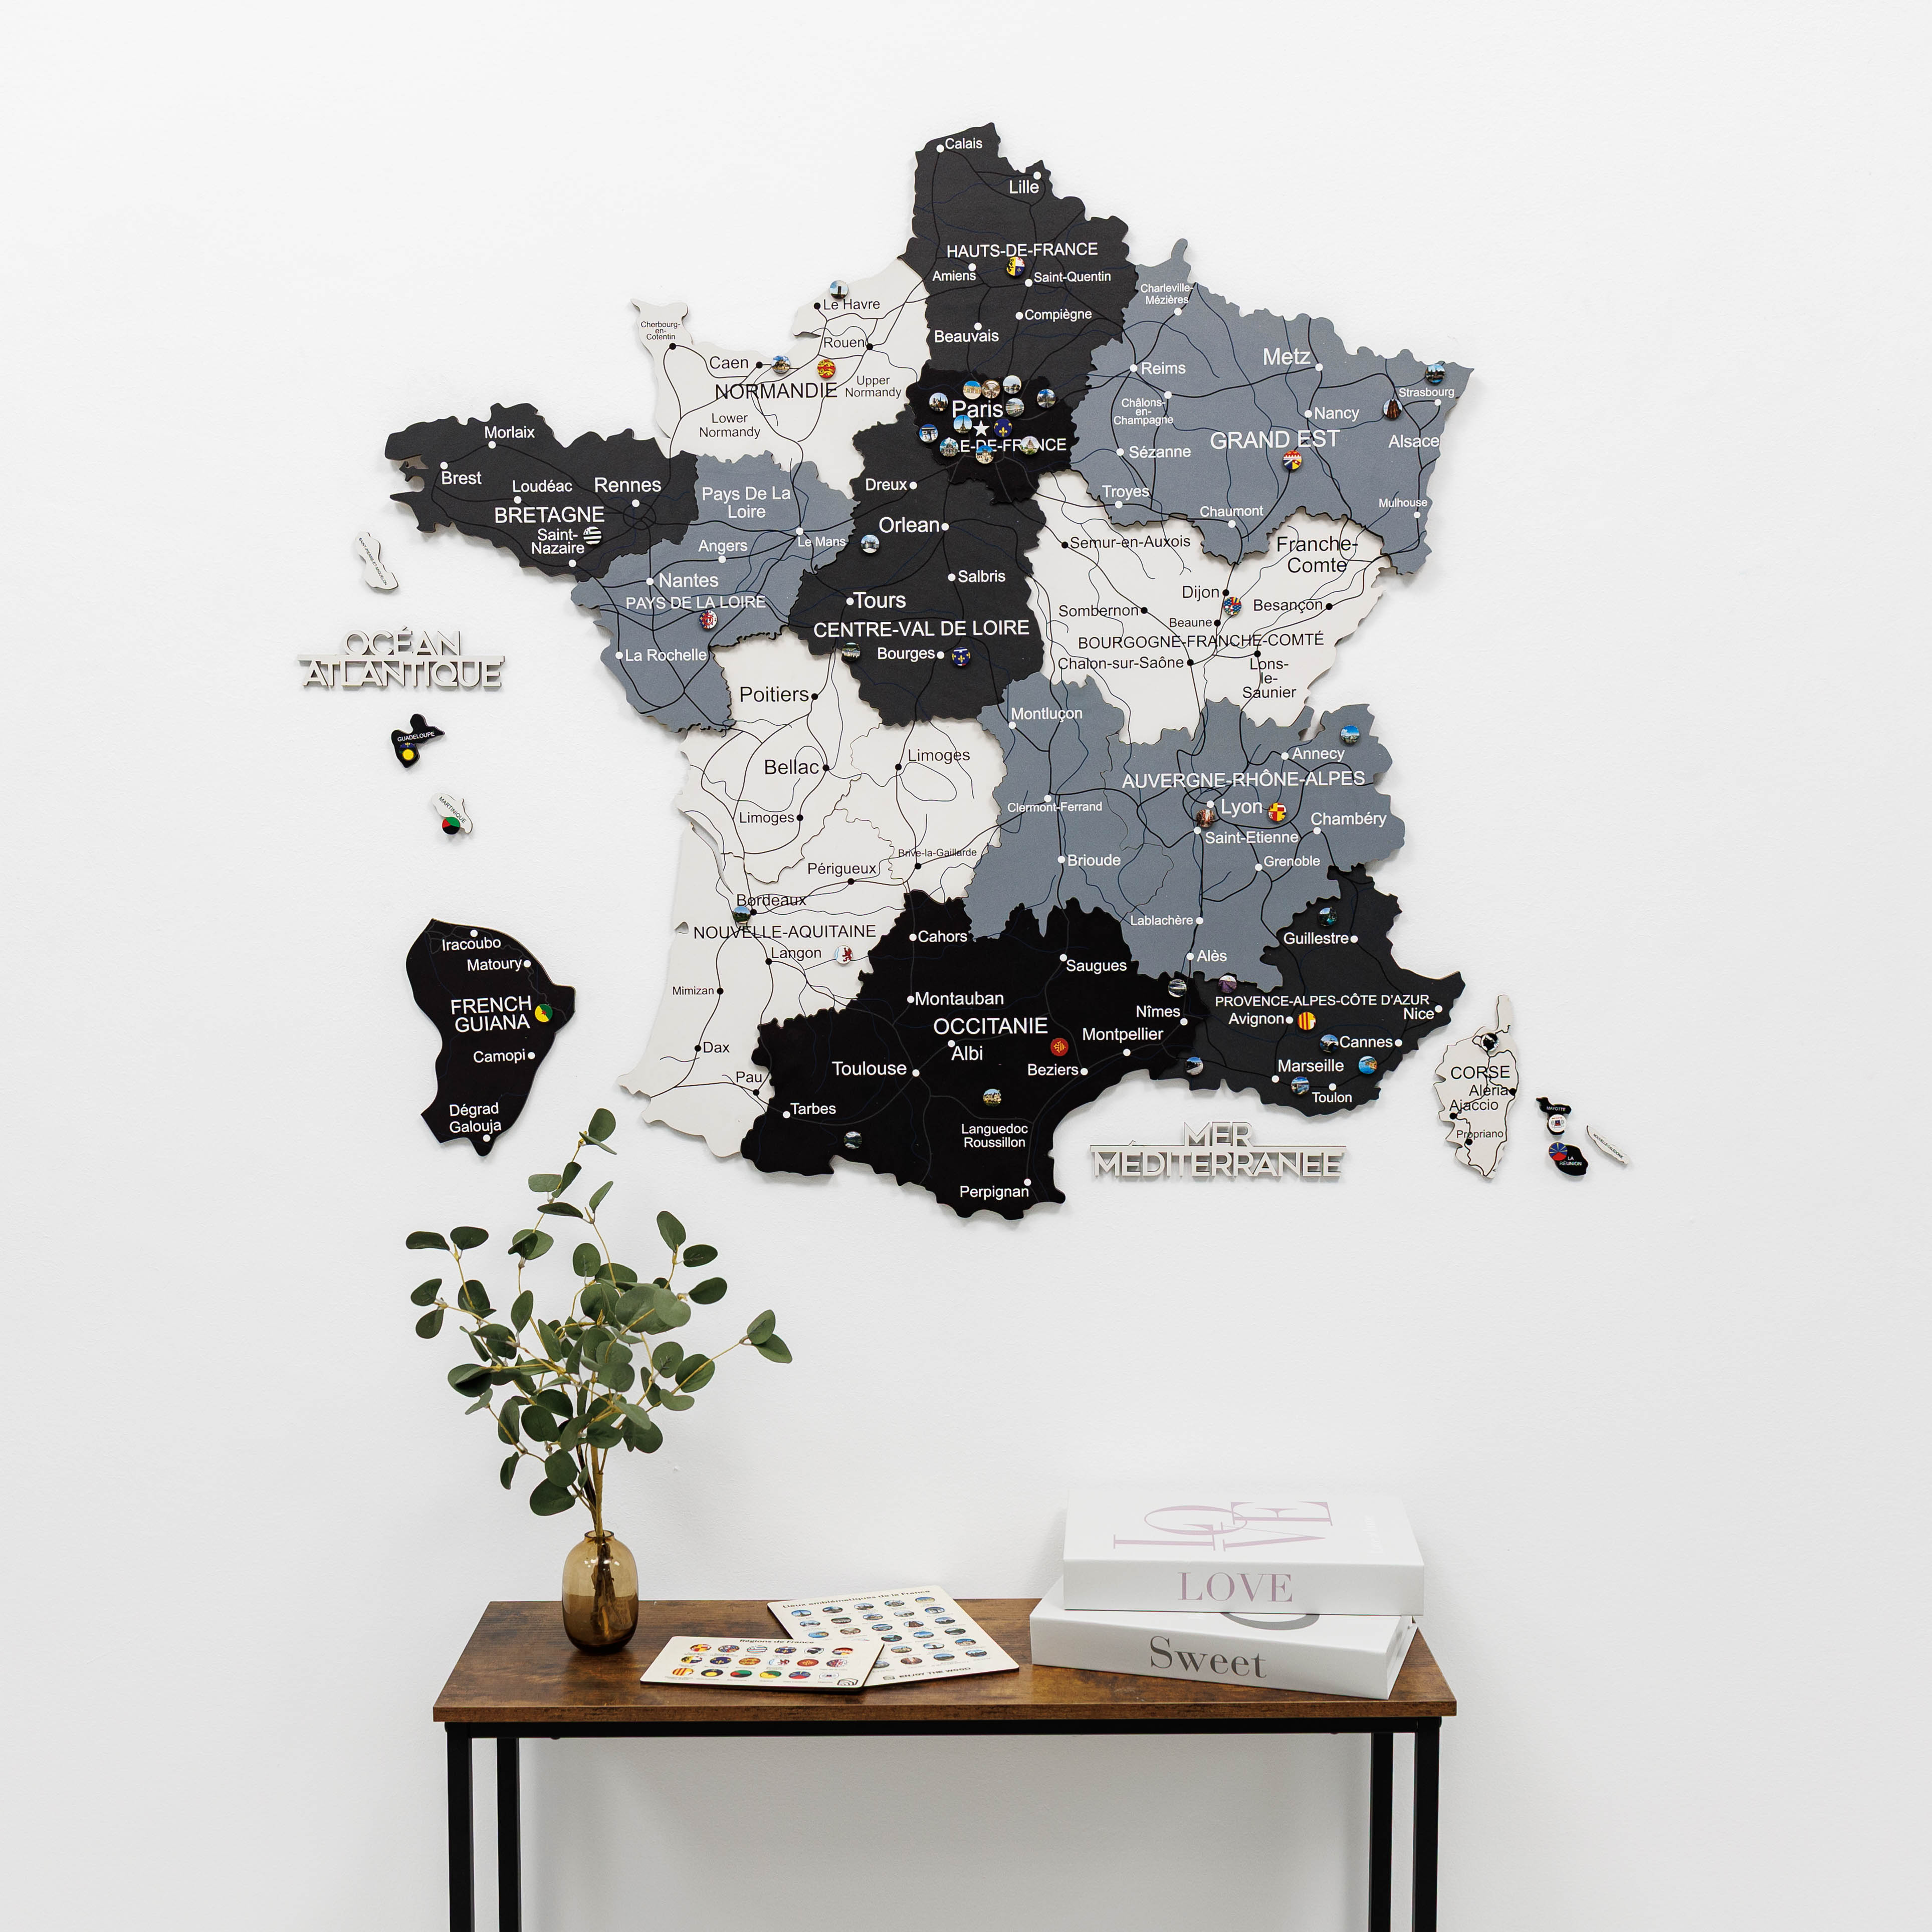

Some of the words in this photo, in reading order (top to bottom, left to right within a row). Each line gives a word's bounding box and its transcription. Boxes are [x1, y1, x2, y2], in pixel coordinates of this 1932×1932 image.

[946, 138, 982, 149] Calais
[1010, 180, 1039, 193] Lille
[948, 243, 1098, 258] HAUTS-DE-FRANCE
[933, 270, 976, 281] Amiens
[1034, 271, 1111, 282] Saint-Quentin
[1141, 283, 1193, 293] Charleville-
[824, 299, 838, 310] Le
[843, 300, 880, 310] Havre
[1146, 295, 1188, 304] Mézières
[1025, 309, 1092, 322] Compiègne
[935, 329, 999, 342] Beauvais
[824, 337, 865, 348] Rouen
[710, 356, 748, 369] Caen
[1264, 348, 1311, 365] Metz
[1142, 362, 1185, 374] Reims
[857, 376, 890, 387] Upper
[716, 383, 837, 398] NORMANDIE
[846, 387, 901, 399] Normandy
[1399, 388, 1454, 398] Strasbourg
[952, 400, 1003, 418] Paris
[1122, 398, 1165, 407] Châlons-
[712, 413, 748, 423] Lower
[1315, 407, 1359, 421] Nancy
[1114, 416, 1173, 426] Champagne
[485, 425, 535, 438] Morlaix
[700, 426, 760, 439] Normandy
[1211, 431, 1290, 449] GRAND
[1298, 430, 1340, 447] EST
[1389, 435, 1439, 448] Alsace
[1129, 446, 1191, 458] Sézanne
[442, 471, 482, 484] Brest
[513, 480, 572, 492] Loudéac
[595, 478, 661, 492] Rennes
[866, 479, 907, 490] Dreux
[703, 487, 740, 504] Pays
[746, 487, 766, 500] De
[773, 486, 790, 499] La
[1102, 485, 1149, 500] Troyes
[1379, 498, 1427, 507] Mulhouse
[495, 506, 604, 523] BRETAGNE
[729, 505, 765, 518] Loire
[1200, 506, 1263, 517] Chaumont
[880, 517, 939, 533] Orlean
[538, 528, 578, 541] Saint-
[532, 542, 584, 554] Nazaire
[699, 540, 747, 554] Angers
[798, 537, 811, 546] Le
[816, 537, 845, 546] Mans
[1070, 535, 1190, 549] Semur-en-Auxois
[1277, 536, 1358, 551] Franche-
[1287, 558, 1347, 573] Comte
[660, 573, 718, 587] Nantes
[958, 570, 1005, 582] Salbris
[853, 592, 906, 608] Tours
[1183, 586, 1219, 601] Dijon
[626, 597, 666, 609] PAYS
[671, 597, 692, 608] DE
[697, 596, 715, 608] LA
[720, 596, 766, 608] LOIRE
[1254, 599, 1323, 613] Besançon
[1059, 605, 1139, 617] Sombernon
[814, 621, 935, 637] CENTRE-VAL
[941, 621, 966, 635] DE
[973, 620, 1029, 635] LOIRE
[1170, 618, 1212, 627] Beaune
[344, 626, 460, 656] OCÉAN
[1079, 630, 1324, 649] BOURGOGNE-FRANCHE-COMTÉ
[626, 650, 642, 661] La
[648, 649, 707, 661] Rochelle
[878, 648, 935, 662] Bourges
[1058, 657, 1184, 670] Chalon-sur-Saône
[1250, 659, 1289, 671] Lons-
[298, 655, 505, 687] ATLANTIQUE
[1261, 673, 1277, 684] le-
[741, 687, 808, 702] Poitiers
[1243, 686, 1296, 699] Saunier
[1012, 707, 1082, 722] Montluçon
[397, 732, 435, 741] GUADELOUPE
[909, 749, 970, 762] Limoges
[1292, 747, 1345, 762] Annecy
[765, 759, 819, 774] Bellac
[1122, 769, 1365, 788] AUVERGNE-RHÔNE-ALPES
[439, 796, 467, 823] MARTINIQUE
[1008, 802, 1102, 812] Clermont-Ferrand
[1222, 799, 1262, 817] Lyon
[740, 812, 794, 825] Limoges
[1311, 812, 1387, 827] Chambéry
[1206, 831, 1299, 843] Saint-Etienne
[899, 849, 977, 857] Brive-la-Gaillarde
[1068, 854, 1121, 866] Brioude
[1264, 855, 1320, 867] Grenoble
[808, 863, 876, 877] Périgueux
[737, 894, 806, 906] Bordeaux
[1131, 915, 1193, 925] Lablachère
[694, 925, 876, 939] NOUVELLE-AQUITAINE
[919, 930, 967, 942] Cahors
[1284, 932, 1349, 944] Guillestre
[443, 937, 501, 951] Iracoubo
[772, 948, 821, 961] Langon
[1197, 950, 1227, 961] Alès
[468, 959, 522, 971] Matoury
[1066, 960, 1127, 974] Saugues
[673, 986, 714, 995] Mimizan
[451, 995, 531, 1014] FRENCH
[916, 991, 1003, 1005] Montauban
[1216, 993, 1377, 1006] PROVENCE-ALPES-CÔTE
[1137, 1005, 1180, 1017] Nîmes
[1404, 1008, 1434, 1019] Nice
[455, 1014, 530, 1032] GUIANA
[934, 1017, 1047, 1034] OCCITANIE
[1229, 1013, 1283, 1027] Avignon
[1083, 1027, 1164, 1043] Montpellier
[1340, 1036, 1393, 1047] Cannes
[704, 1042, 729, 1052] Dax
[952, 1046, 982, 1060] Albi
[474, 1048, 525, 1063] Camopi
[832, 1061, 907, 1076] Toulouse
[1028, 1063, 1079, 1076] Beziers
[1278, 1059, 1344, 1072] Marseille
[737, 1071, 762, 1083] Pau
[1451, 1066, 1510, 1079] CORSE
[1312, 1092, 1352, 1103] Toulon
[450, 1102, 498, 1118] Dégrad
[790, 1103, 836, 1114] Tarbes
[1449, 1099, 1498, 1112] Ajaccio
[450, 1121, 501, 1134] Galouja
[962, 1124, 1028, 1136] Languedoc
[1184, 1122, 1253, 1146] MER
[1457, 1130, 1504, 1139] Propriano
[965, 1137, 1025, 1147] Roussillon
[960, 1186, 1028, 1200] Perpignan
[1178, 1572, 1293, 1602] LOVE
[809, 1596, 876, 1605] emblématiques
[1151, 1637, 1266, 1678] Sweet
